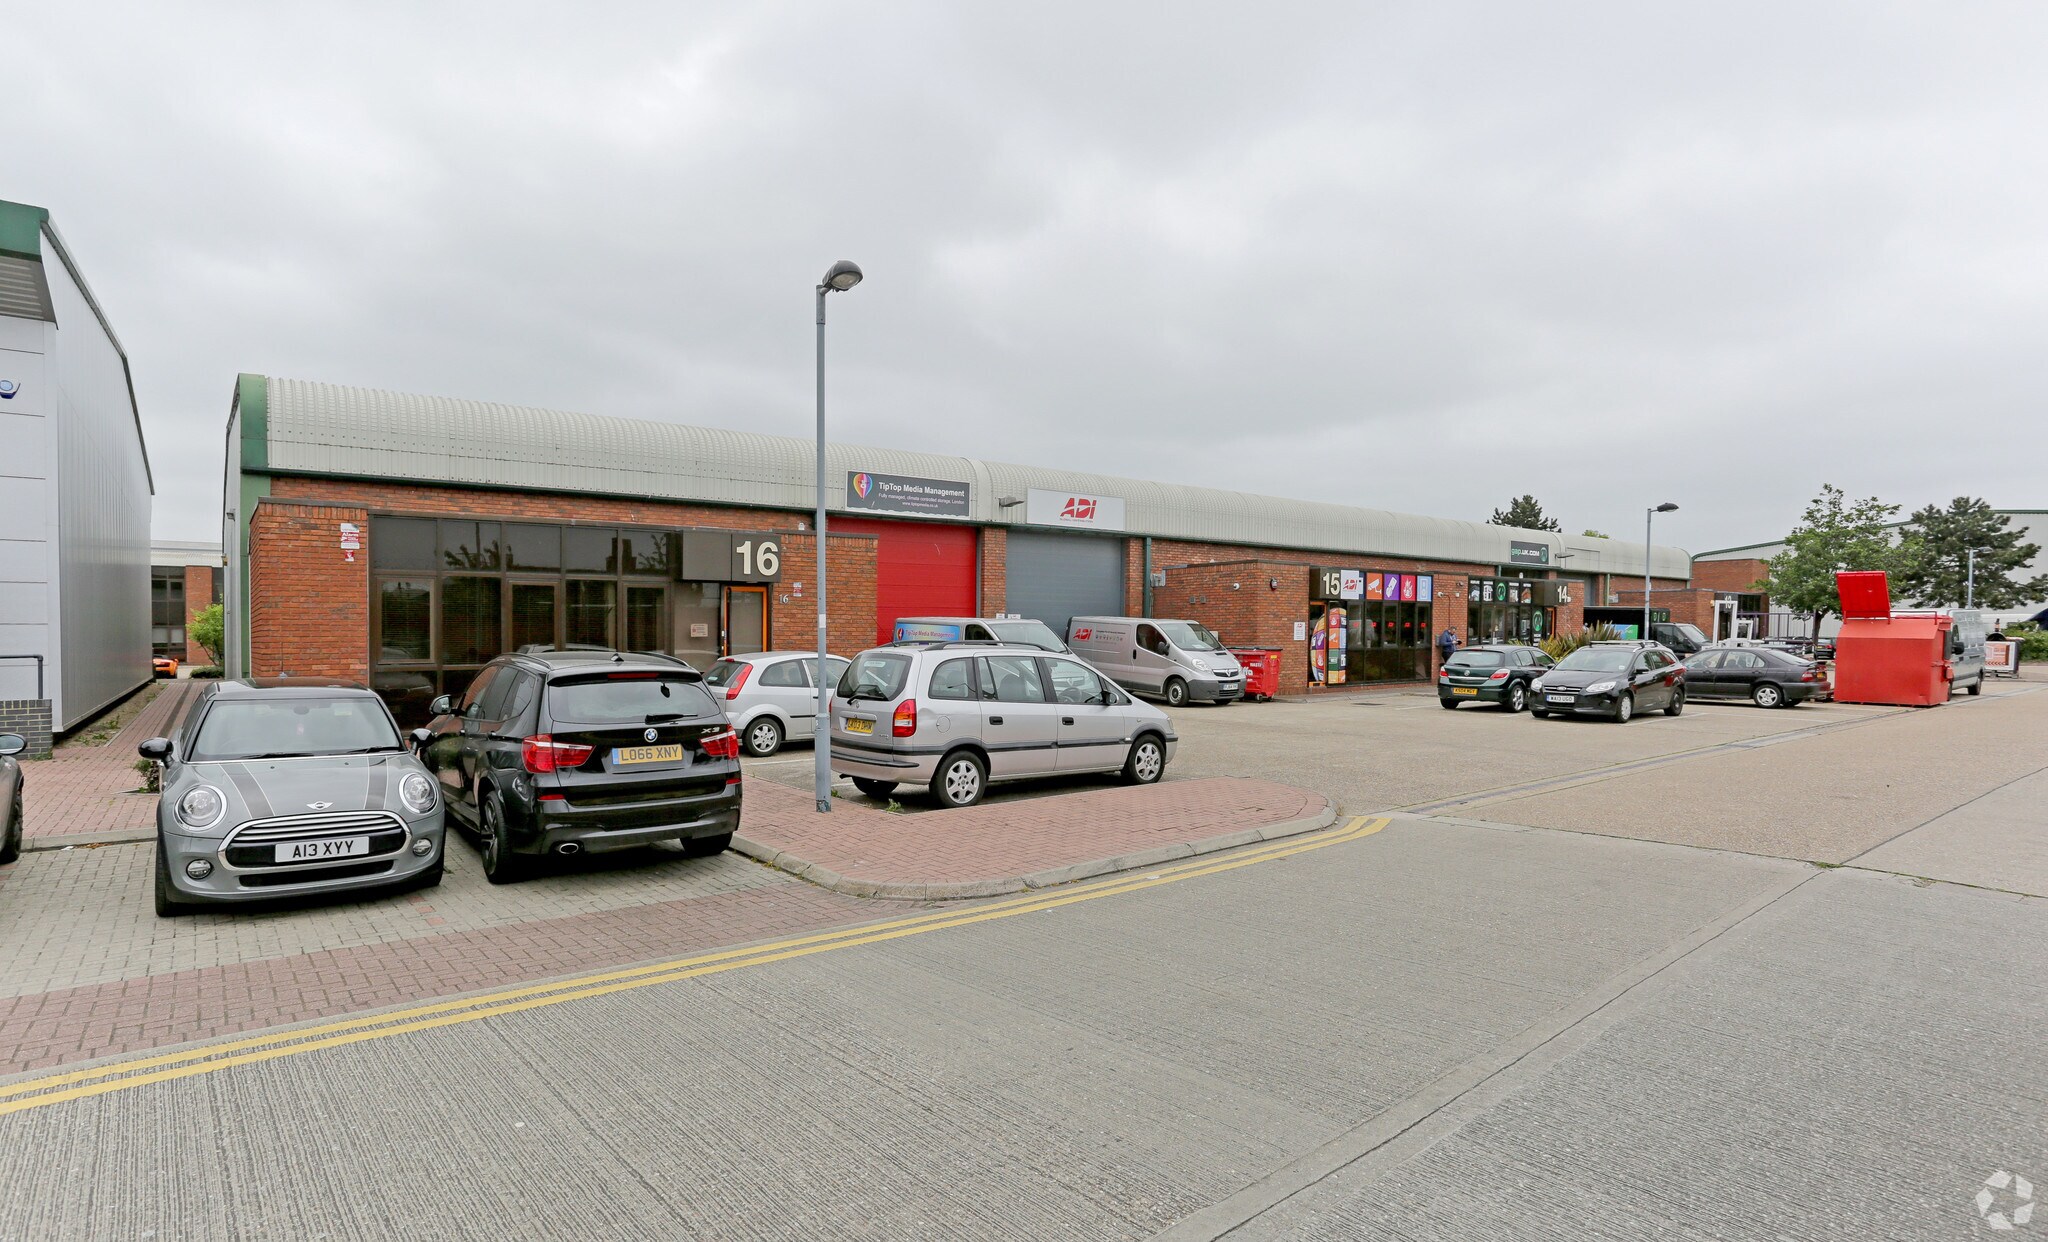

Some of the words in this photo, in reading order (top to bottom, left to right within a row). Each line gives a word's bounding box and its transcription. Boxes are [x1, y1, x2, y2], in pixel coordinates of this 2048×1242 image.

[879, 482, 902, 492] TipTop
[903, 485, 923, 493] Media
[924, 486, 965, 497] Management
[1060, 497, 1097, 519] ADI
[736, 540, 779, 576] 16
[1323, 572, 1340, 595] 15
[1343, 579, 1357, 590] ADI
[779, 593, 789, 603] 16
[1558, 585, 1568, 603] 14
[1073, 628, 1092, 640] ADI
[701, 726, 720, 734] X3
[656, 746, 680, 759] XNY
[323, 840, 354, 856] XYY
